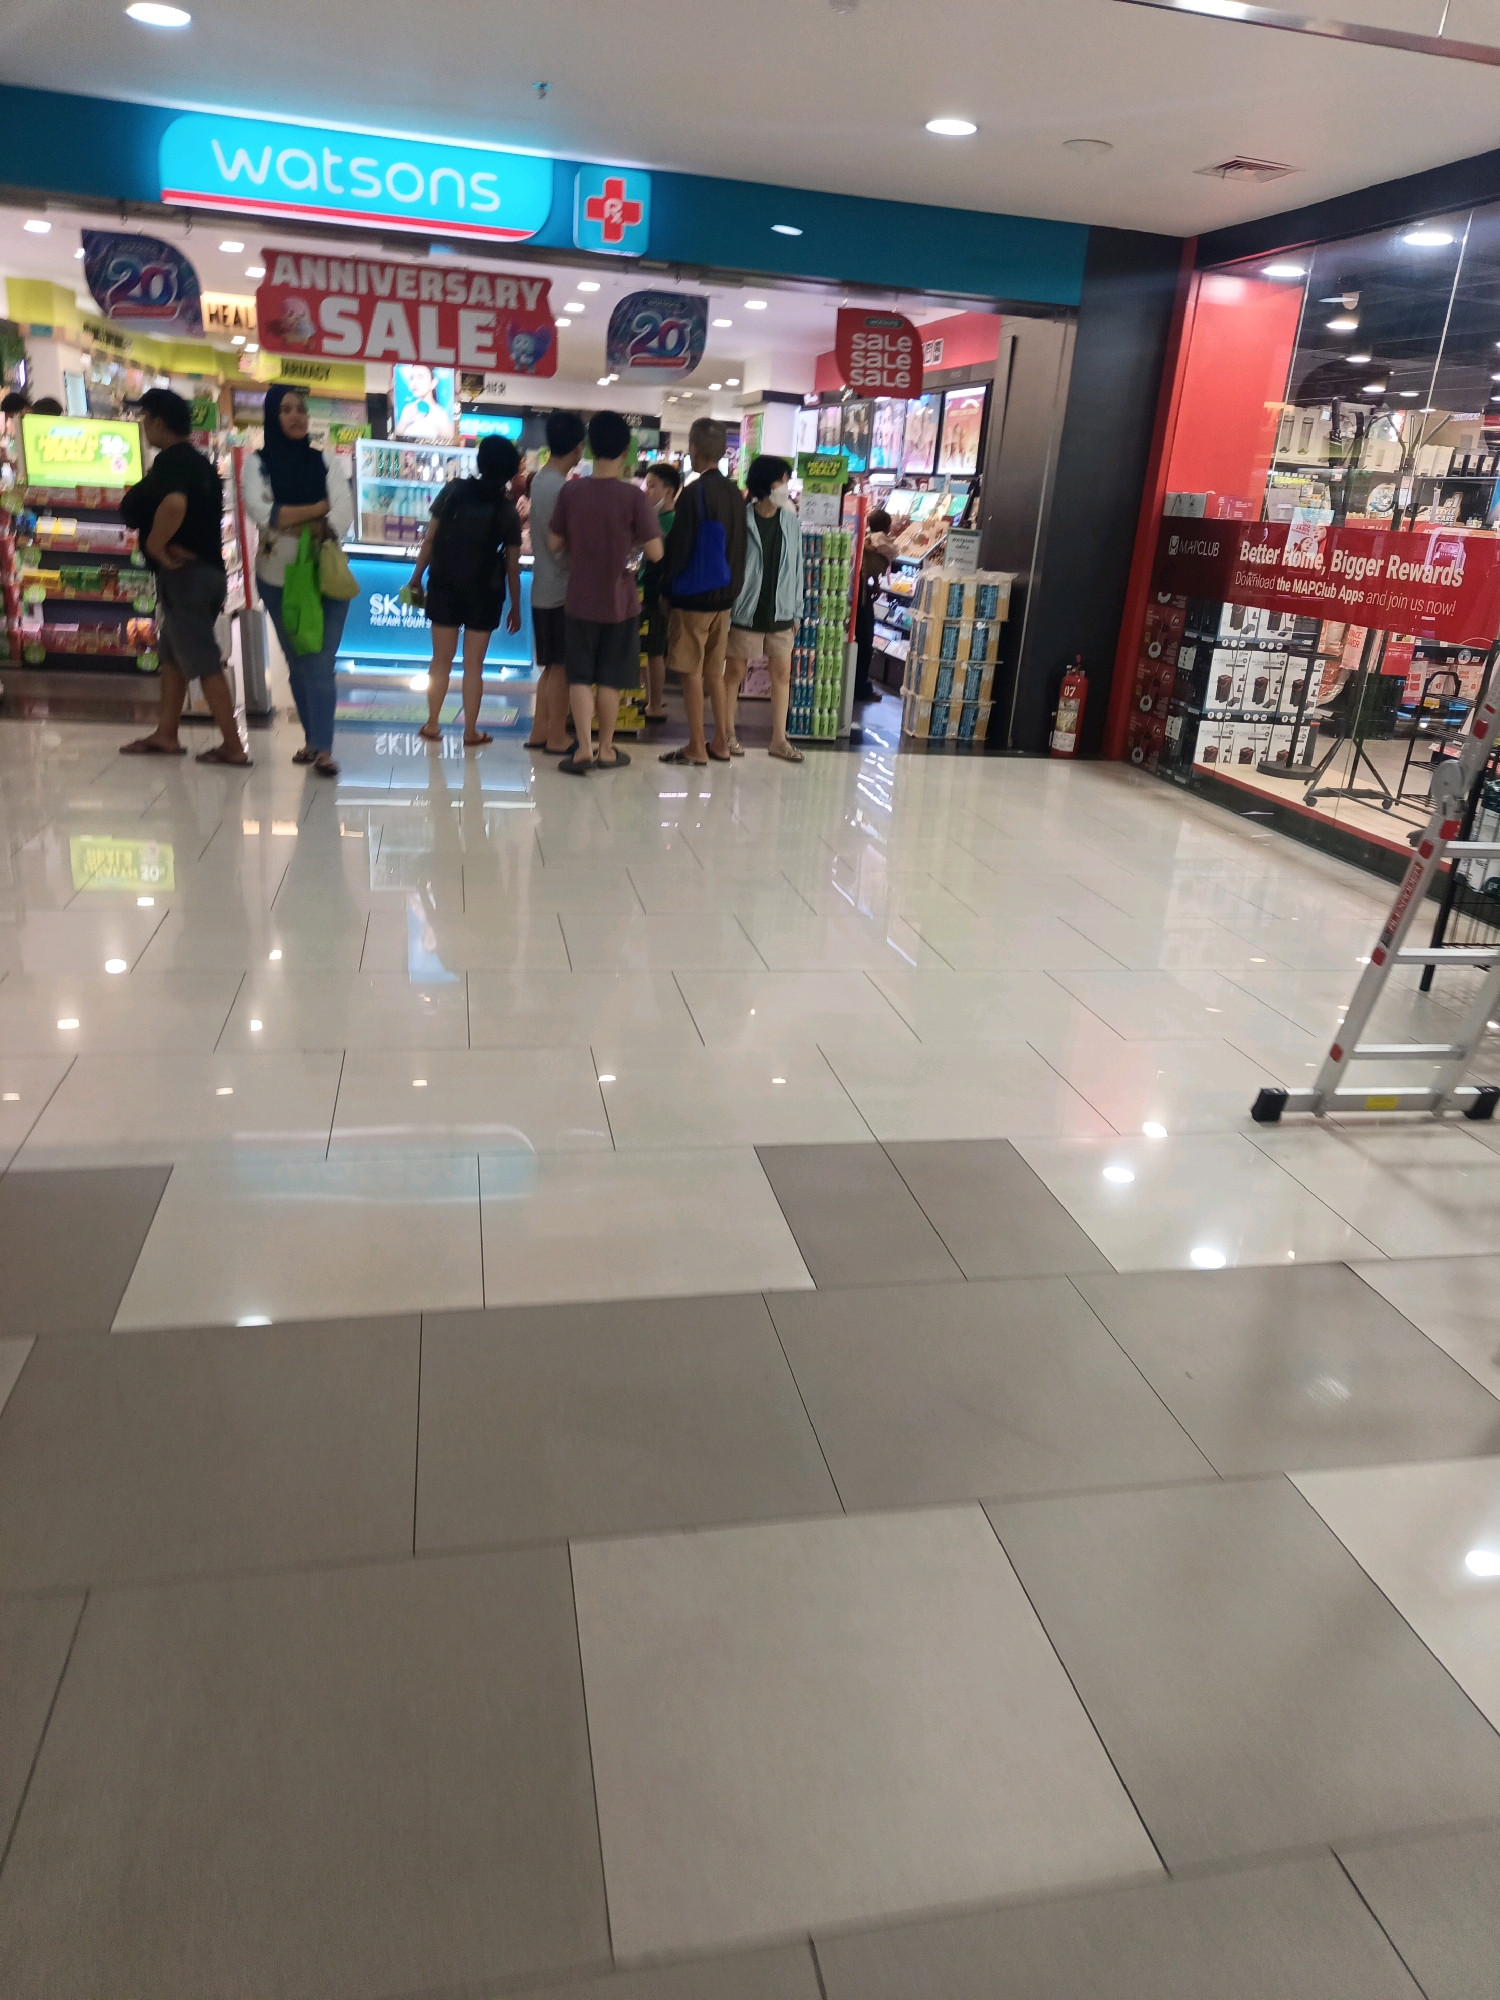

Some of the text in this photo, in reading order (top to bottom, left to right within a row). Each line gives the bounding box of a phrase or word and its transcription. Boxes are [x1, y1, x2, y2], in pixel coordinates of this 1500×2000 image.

[211, 138, 501, 213] watsons
[271, 254, 544, 312] ANNIVERSARY
[208, 304, 256, 330] HEAL
[318, 294, 498, 368] SALE
[1239, 540, 1465, 588] Better Home, Bigger Rewards
[1234, 571, 1456, 617] Download the MAPClub Apps and join us now!
[1063, 685, 1077, 698] 07
